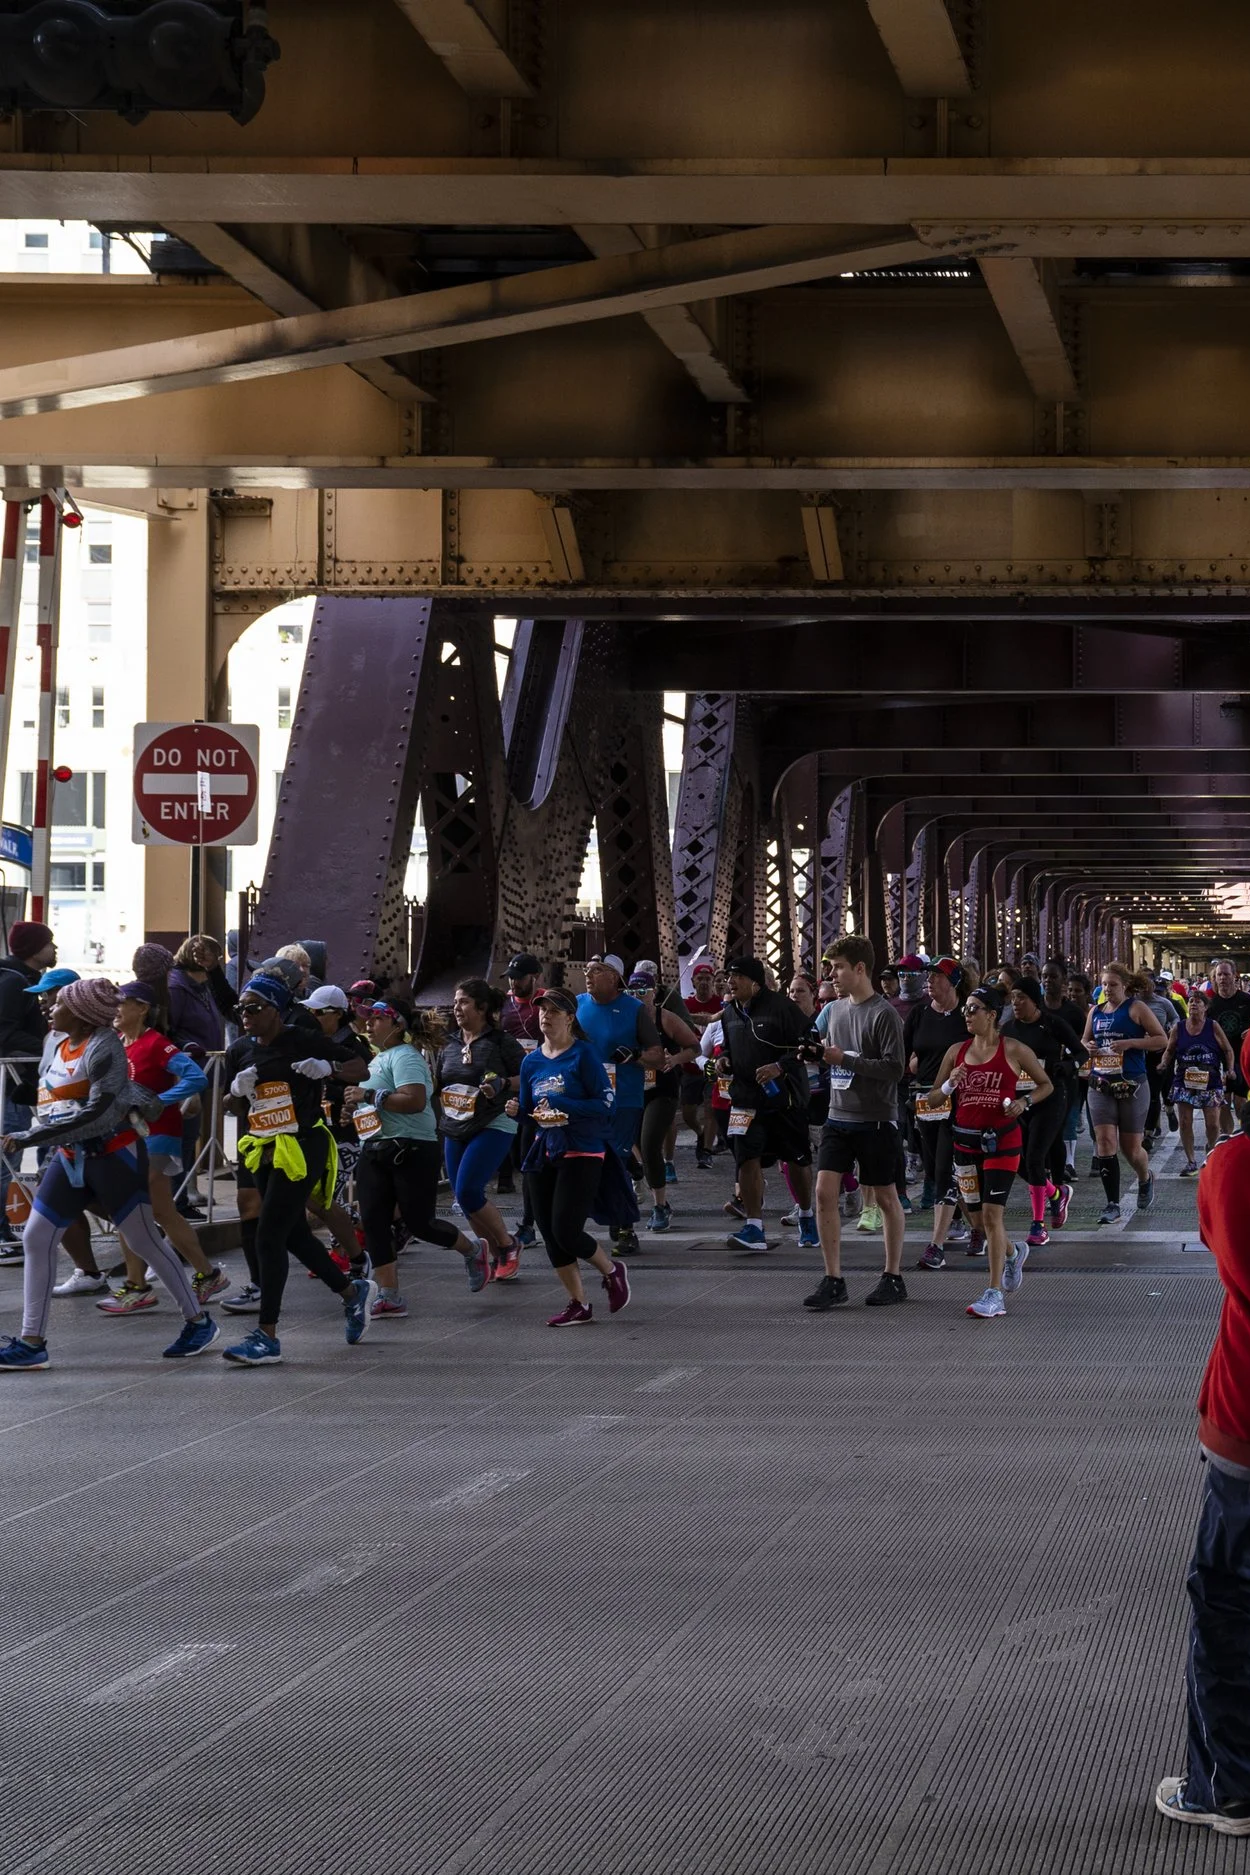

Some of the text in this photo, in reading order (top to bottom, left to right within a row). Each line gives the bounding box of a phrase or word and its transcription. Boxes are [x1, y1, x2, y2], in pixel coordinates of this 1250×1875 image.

[153, 748, 239, 767] DO NOT
[264, 1085, 288, 1096] 57000
[251, 1108, 291, 1128] L 57000
